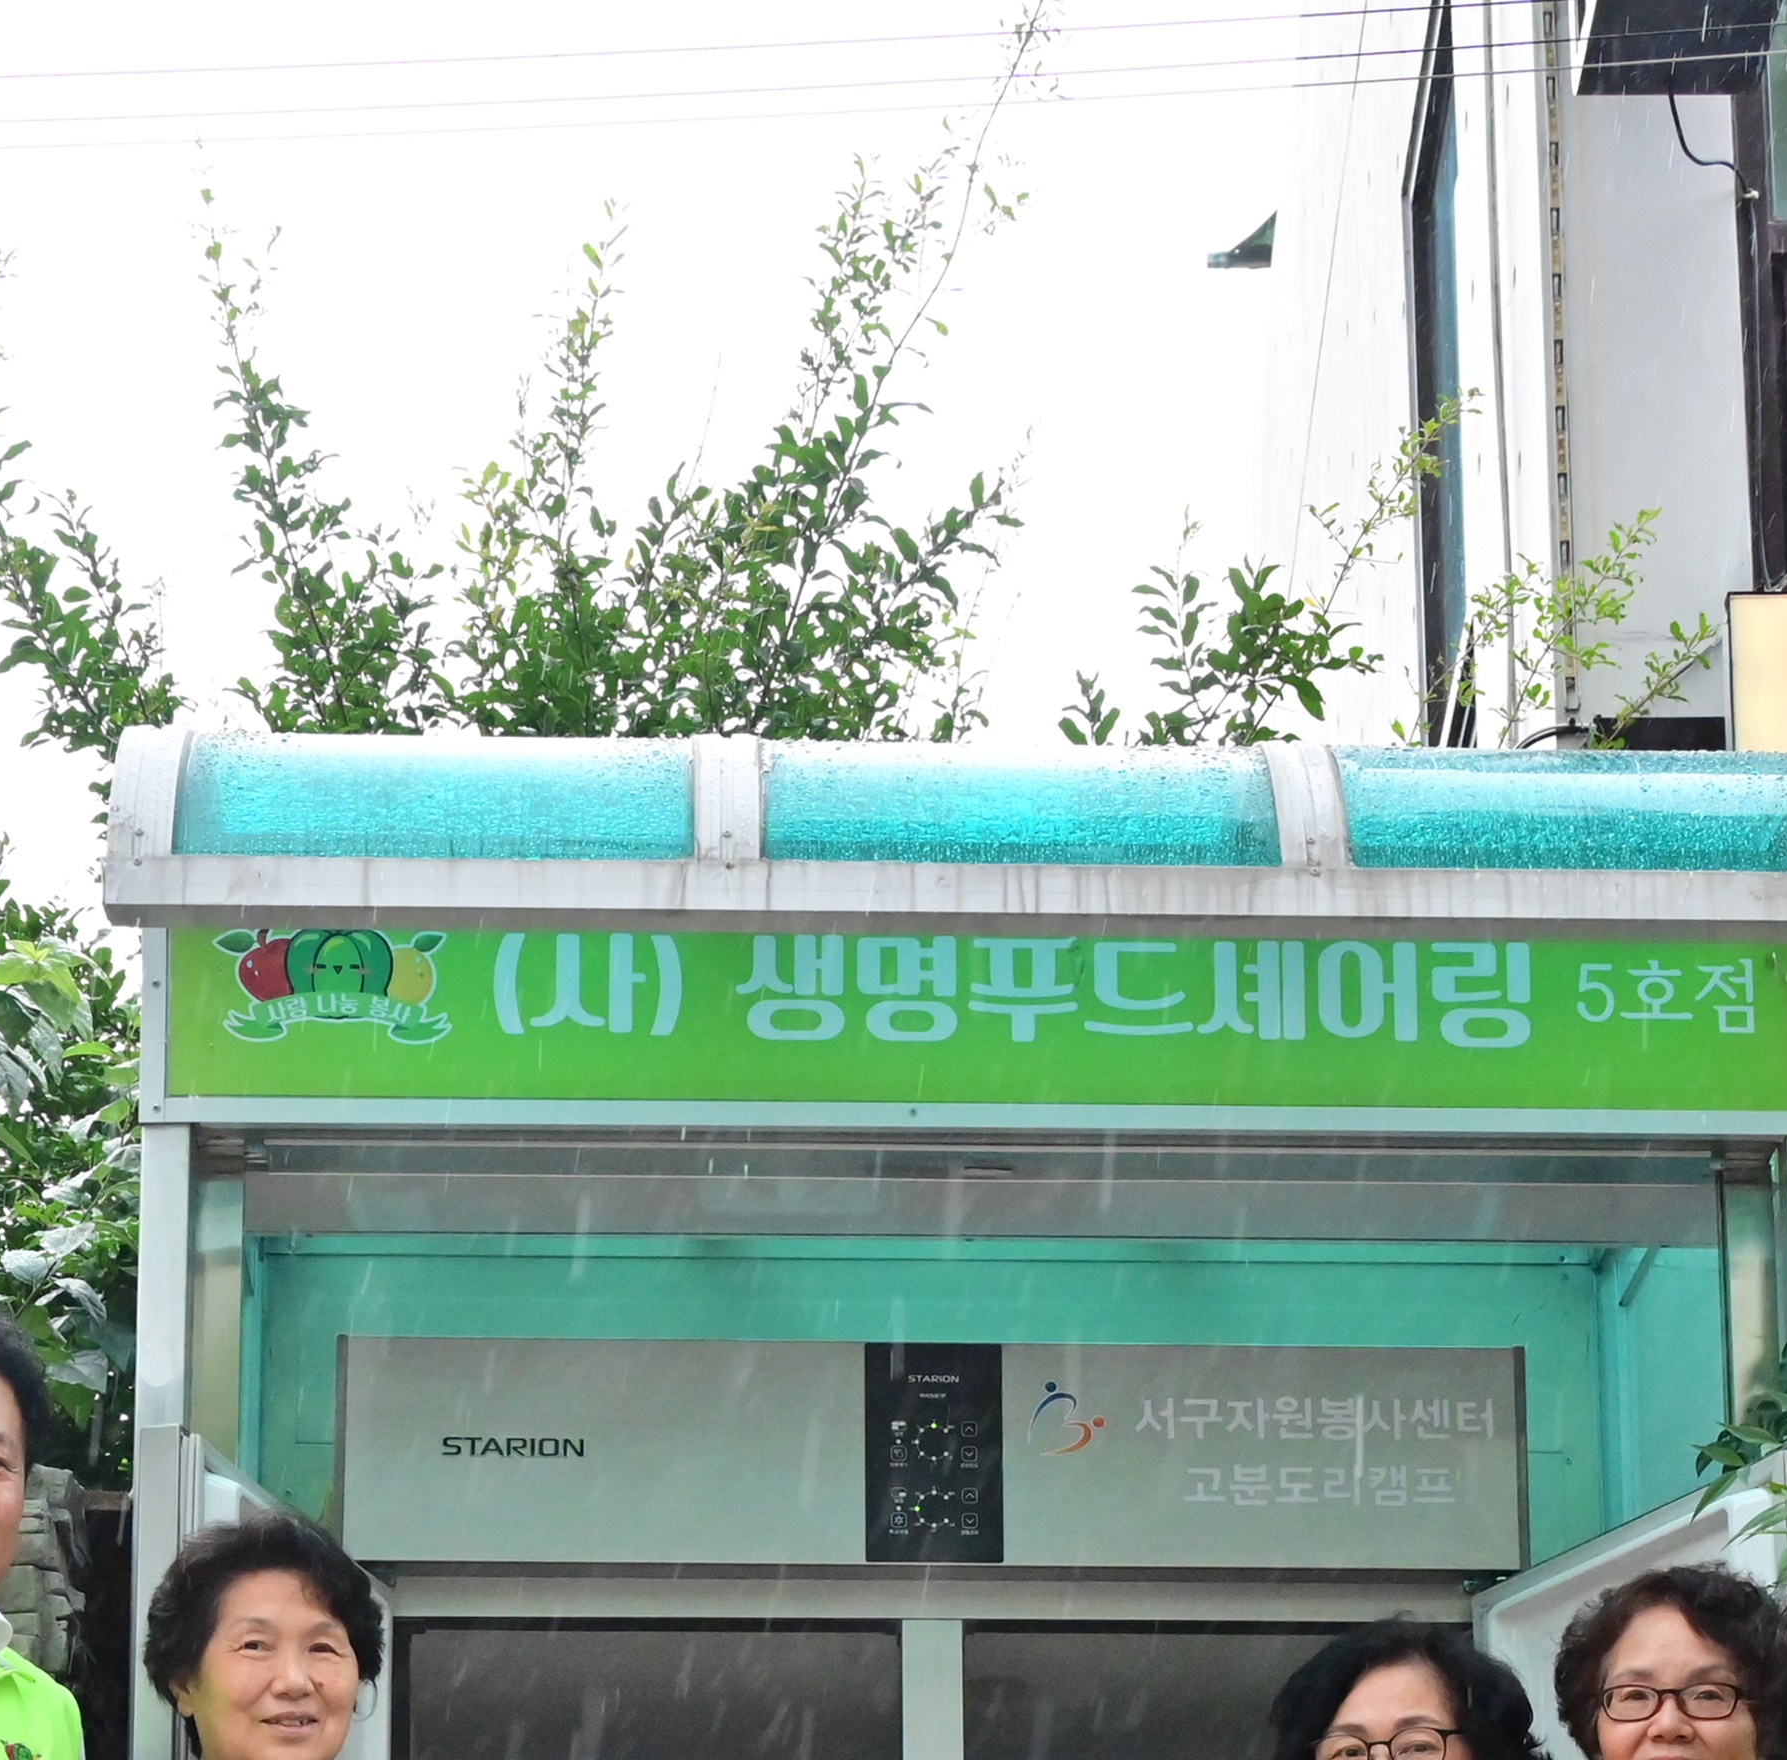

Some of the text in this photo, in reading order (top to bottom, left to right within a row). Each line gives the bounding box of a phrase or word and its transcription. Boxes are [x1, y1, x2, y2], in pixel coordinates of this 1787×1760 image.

[493, 932, 1756, 1049] (사) 생명푸드셰어링 5호점
[267, 996, 308, 1023] 사랑
[369, 996, 412, 1024] 봉사
[908, 1374, 960, 1384] STARION
[1135, 1395, 1495, 1441] 서구자원봉사센터
[442, 1436, 585, 1458] STARION
[1182, 1463, 1457, 1506] 고분도리캠프
